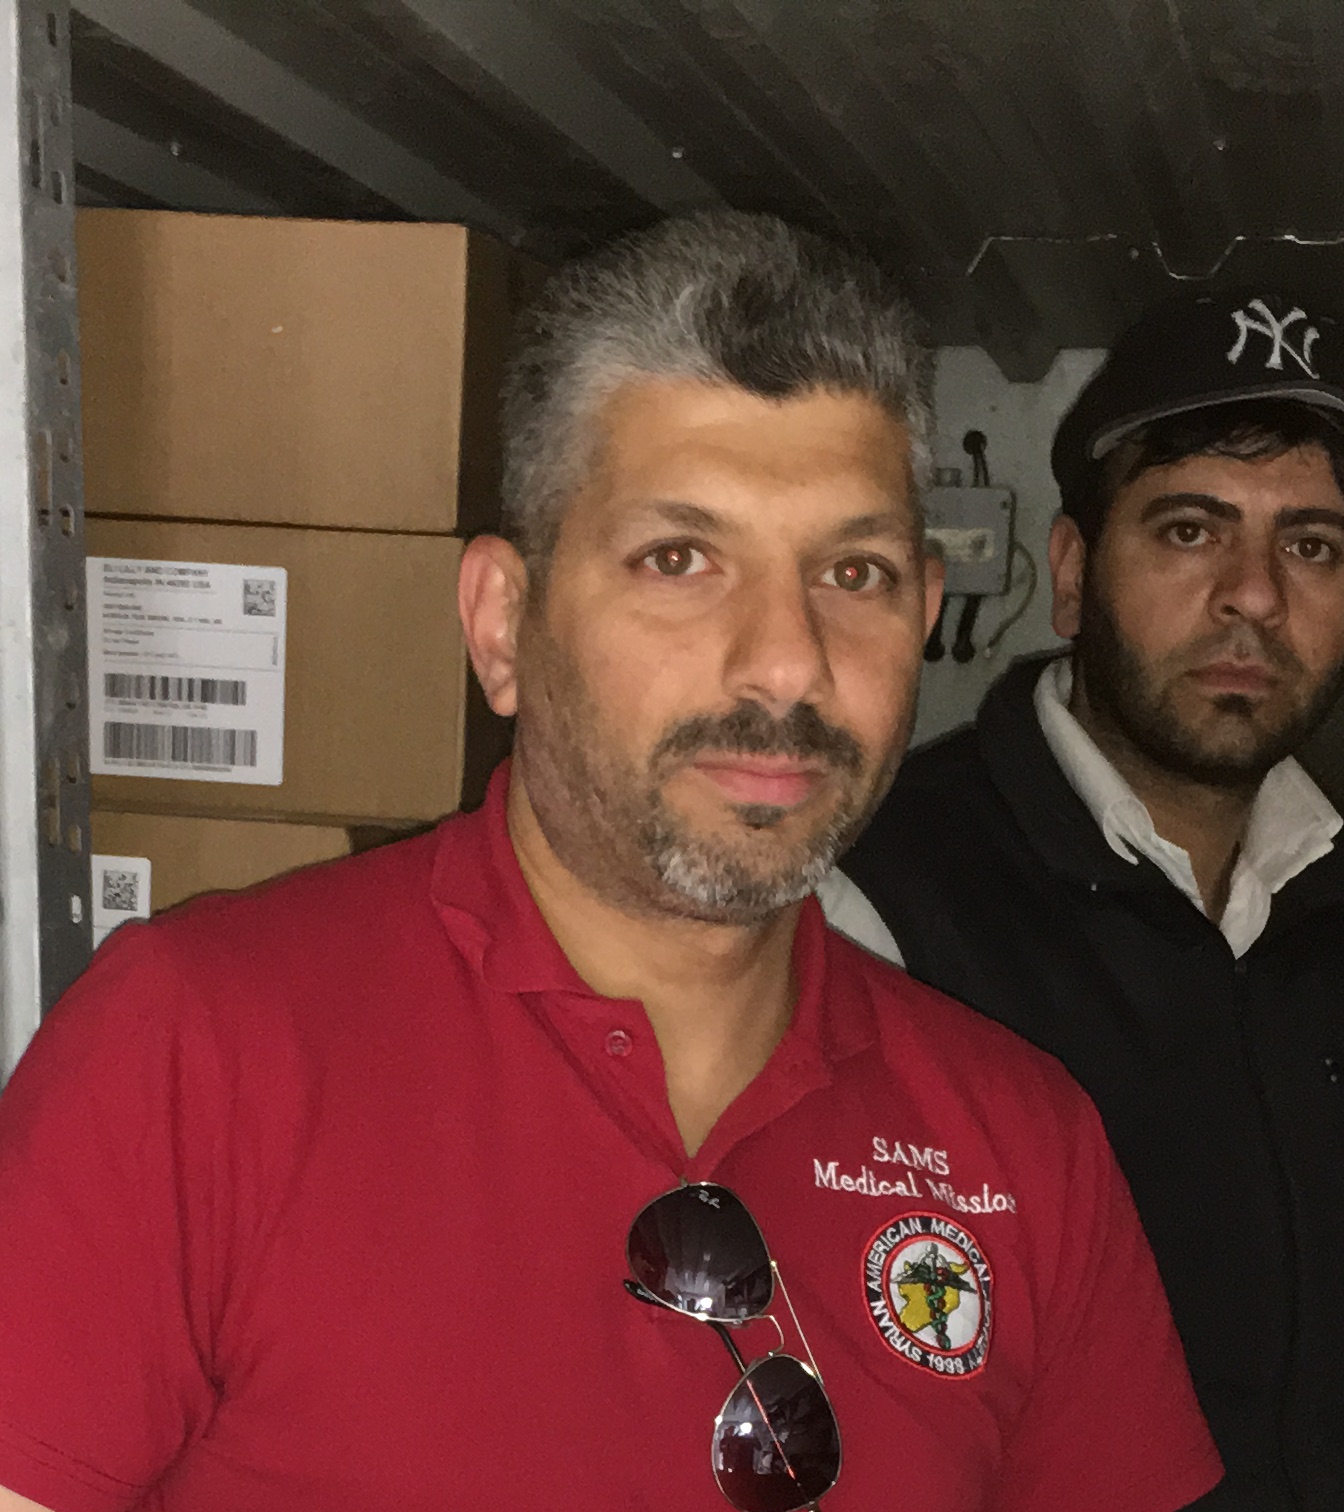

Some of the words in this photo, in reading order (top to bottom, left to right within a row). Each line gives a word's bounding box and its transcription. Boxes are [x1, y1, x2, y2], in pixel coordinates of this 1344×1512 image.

[1226, 299, 1320, 380] NY
[812, 1158, 923, 1198] Medical
[872, 1136, 950, 1176] SAMS
[866, 1217, 923, 1293] AMERICAN
[869, 1300, 924, 1363] SYRIAN
